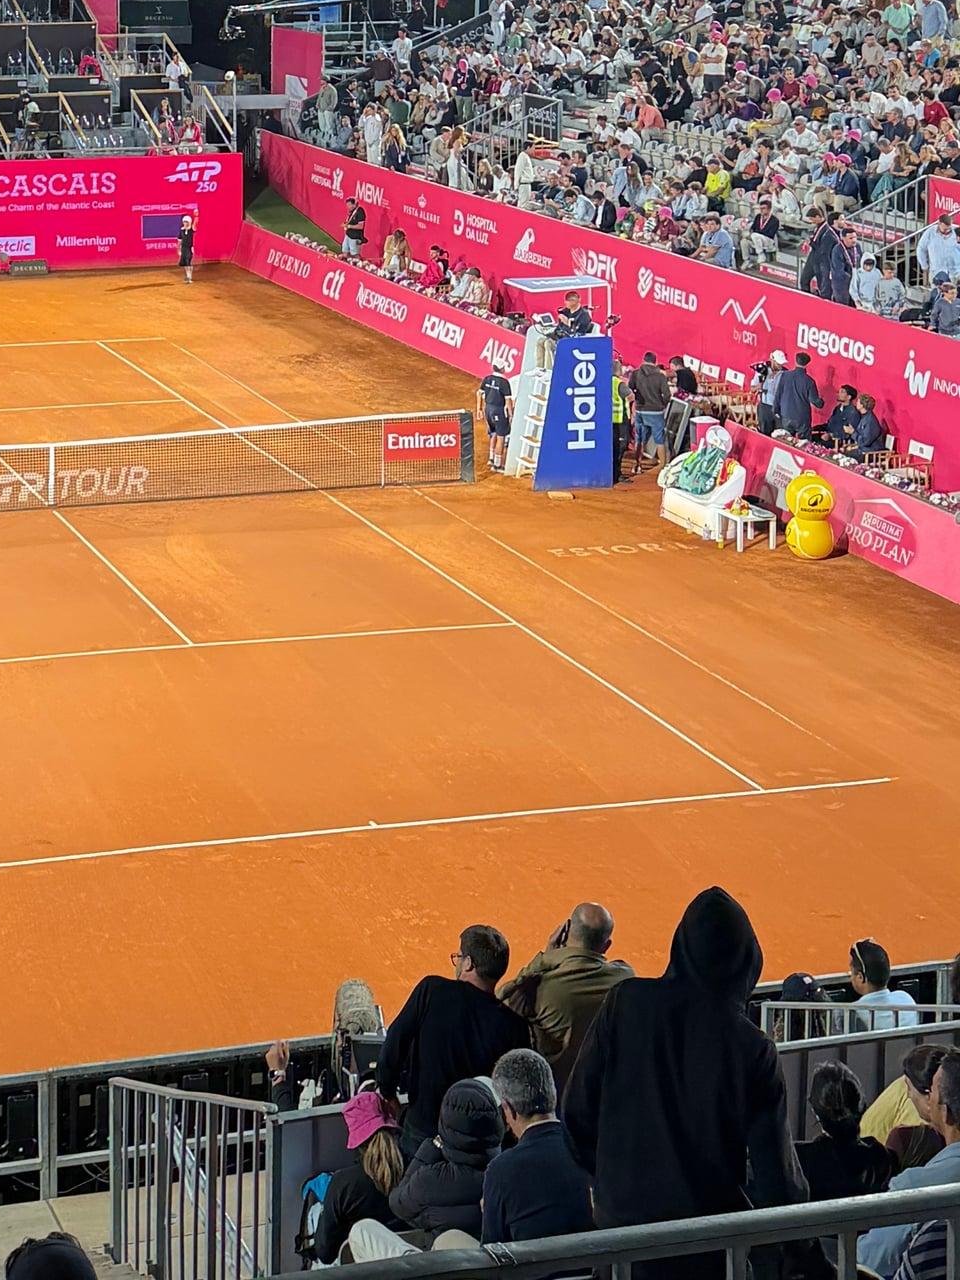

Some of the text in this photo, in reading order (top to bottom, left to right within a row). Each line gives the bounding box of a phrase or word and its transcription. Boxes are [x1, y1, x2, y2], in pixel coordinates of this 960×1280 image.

[164, 161, 222, 182] ATP
[195, 181, 217, 193] 250
[355, 180, 384, 206] MBW
[8, 203, 34, 212] Charm
[35, 203, 45, 211] of
[46, 202, 59, 210] the
[61, 201, 90, 210] Atlantic
[92, 200, 115, 209] Coast
[131, 203, 198, 211] PORSCHE
[403, 204, 441, 224] VISTA ALEGRE
[465, 226, 489, 245] DA LUZ
[466, 213, 498, 234] HOSPITAL
[56, 234, 117, 248] Millennium
[266, 248, 311, 279] DECENIO
[587, 250, 618, 283] DFK
[322, 269, 346, 300] ctt
[653, 282, 697, 312] SHIELD
[355, 281, 408, 323] NESPRESSO
[421, 313, 465, 349] HOWDEN
[479, 337, 519, 373] AVIS
[565, 348, 596, 450] Haier
[387, 431, 457, 450] Emirates
[57, 464, 150, 499] TOUR
[871, 518, 902, 538] PURINA
[845, 523, 913, 567] PRO PLAN
